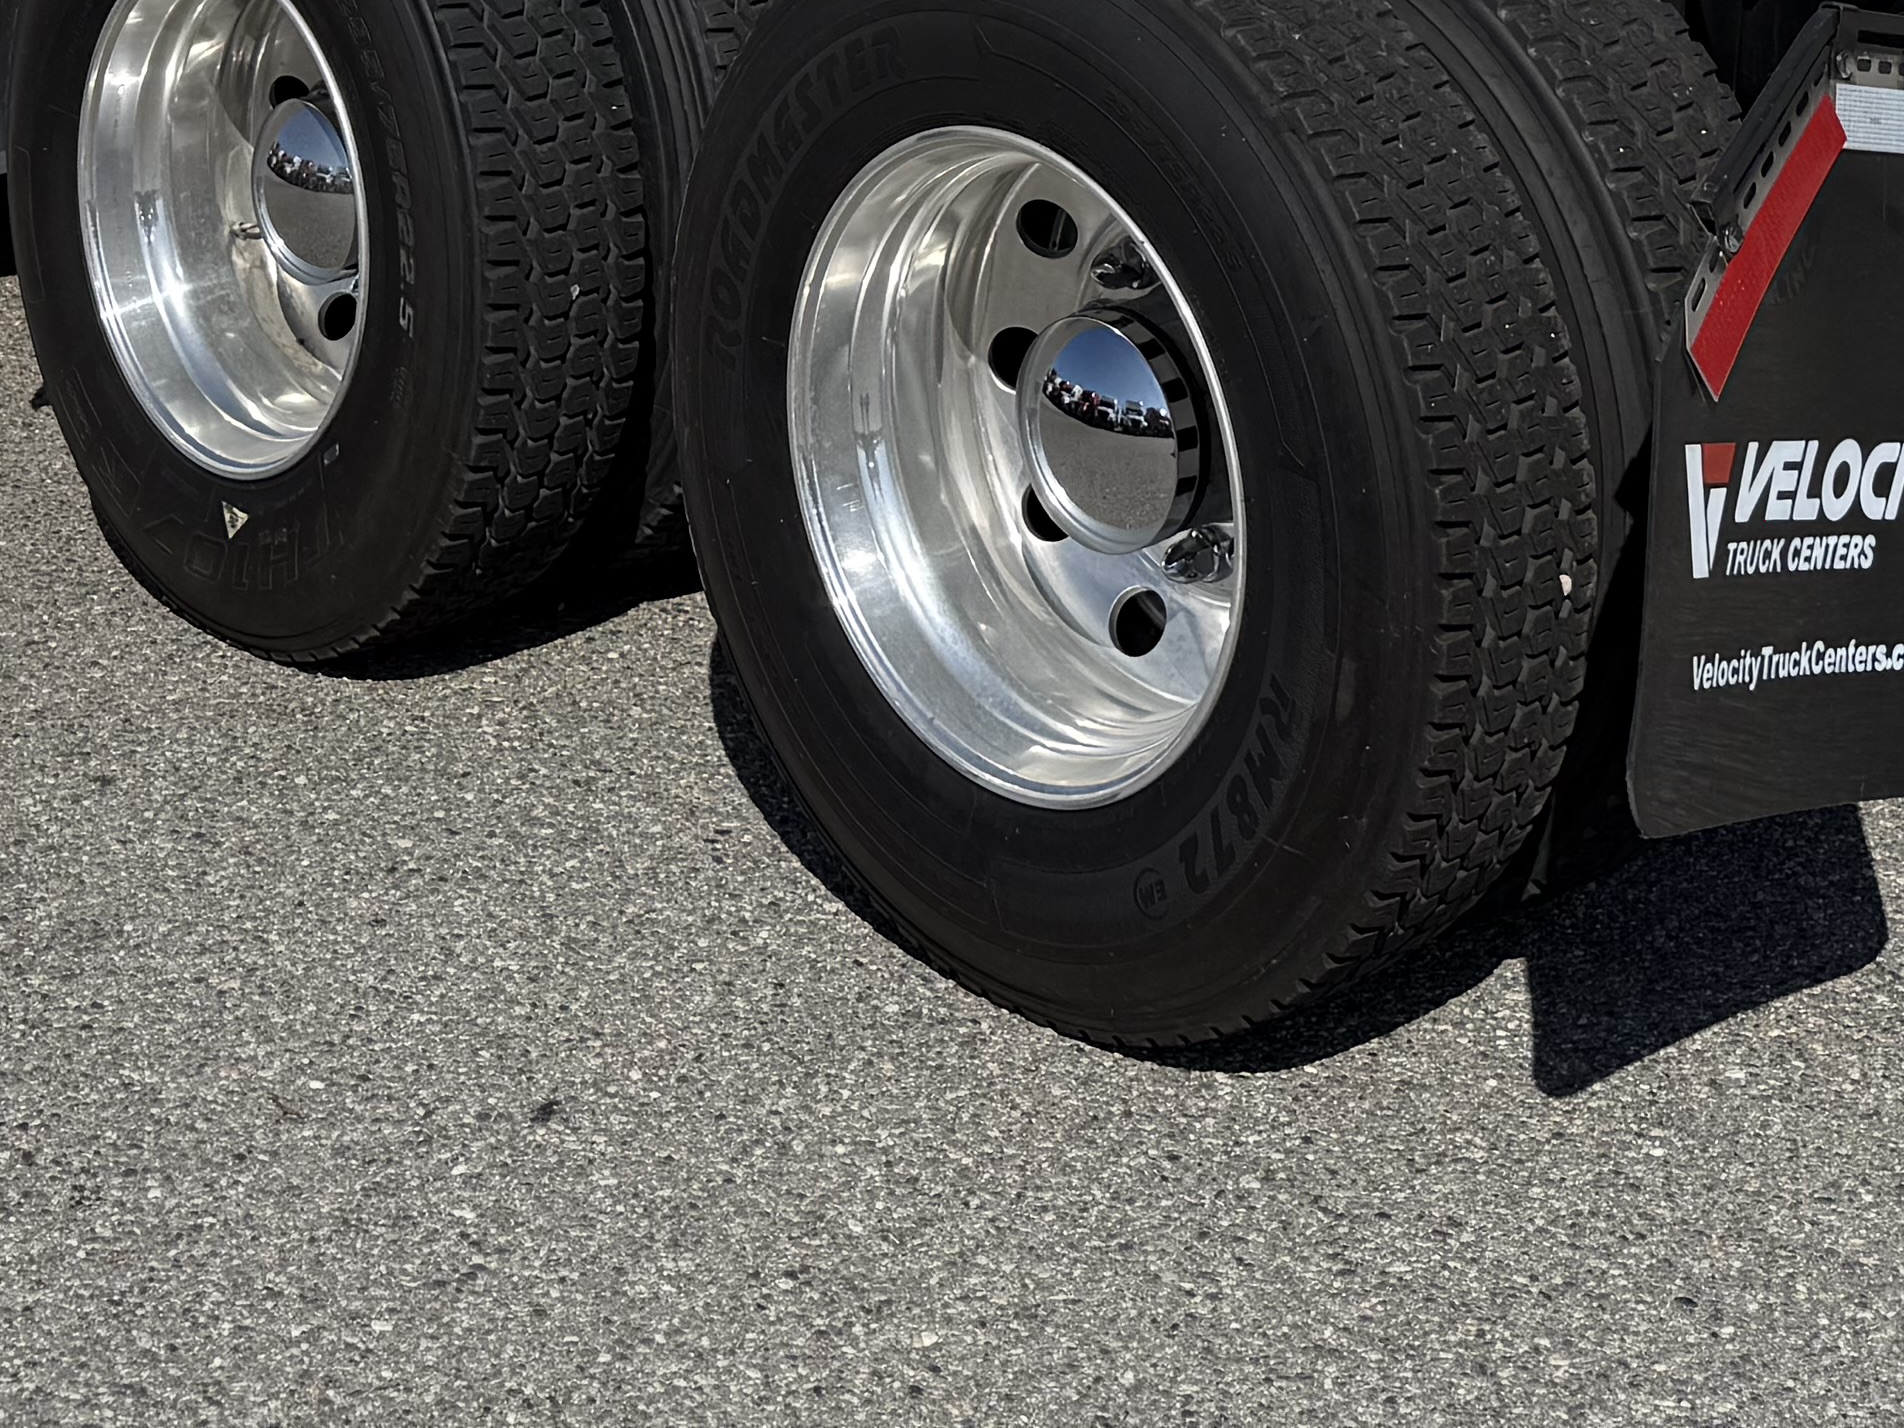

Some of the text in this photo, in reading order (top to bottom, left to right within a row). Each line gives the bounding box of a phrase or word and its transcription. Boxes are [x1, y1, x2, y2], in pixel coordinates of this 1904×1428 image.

[704, 24, 908, 373] ROADMASTER
[1726, 533, 1876, 576] TRUCK CENTERS
[1178, 673, 1296, 894] RM872
